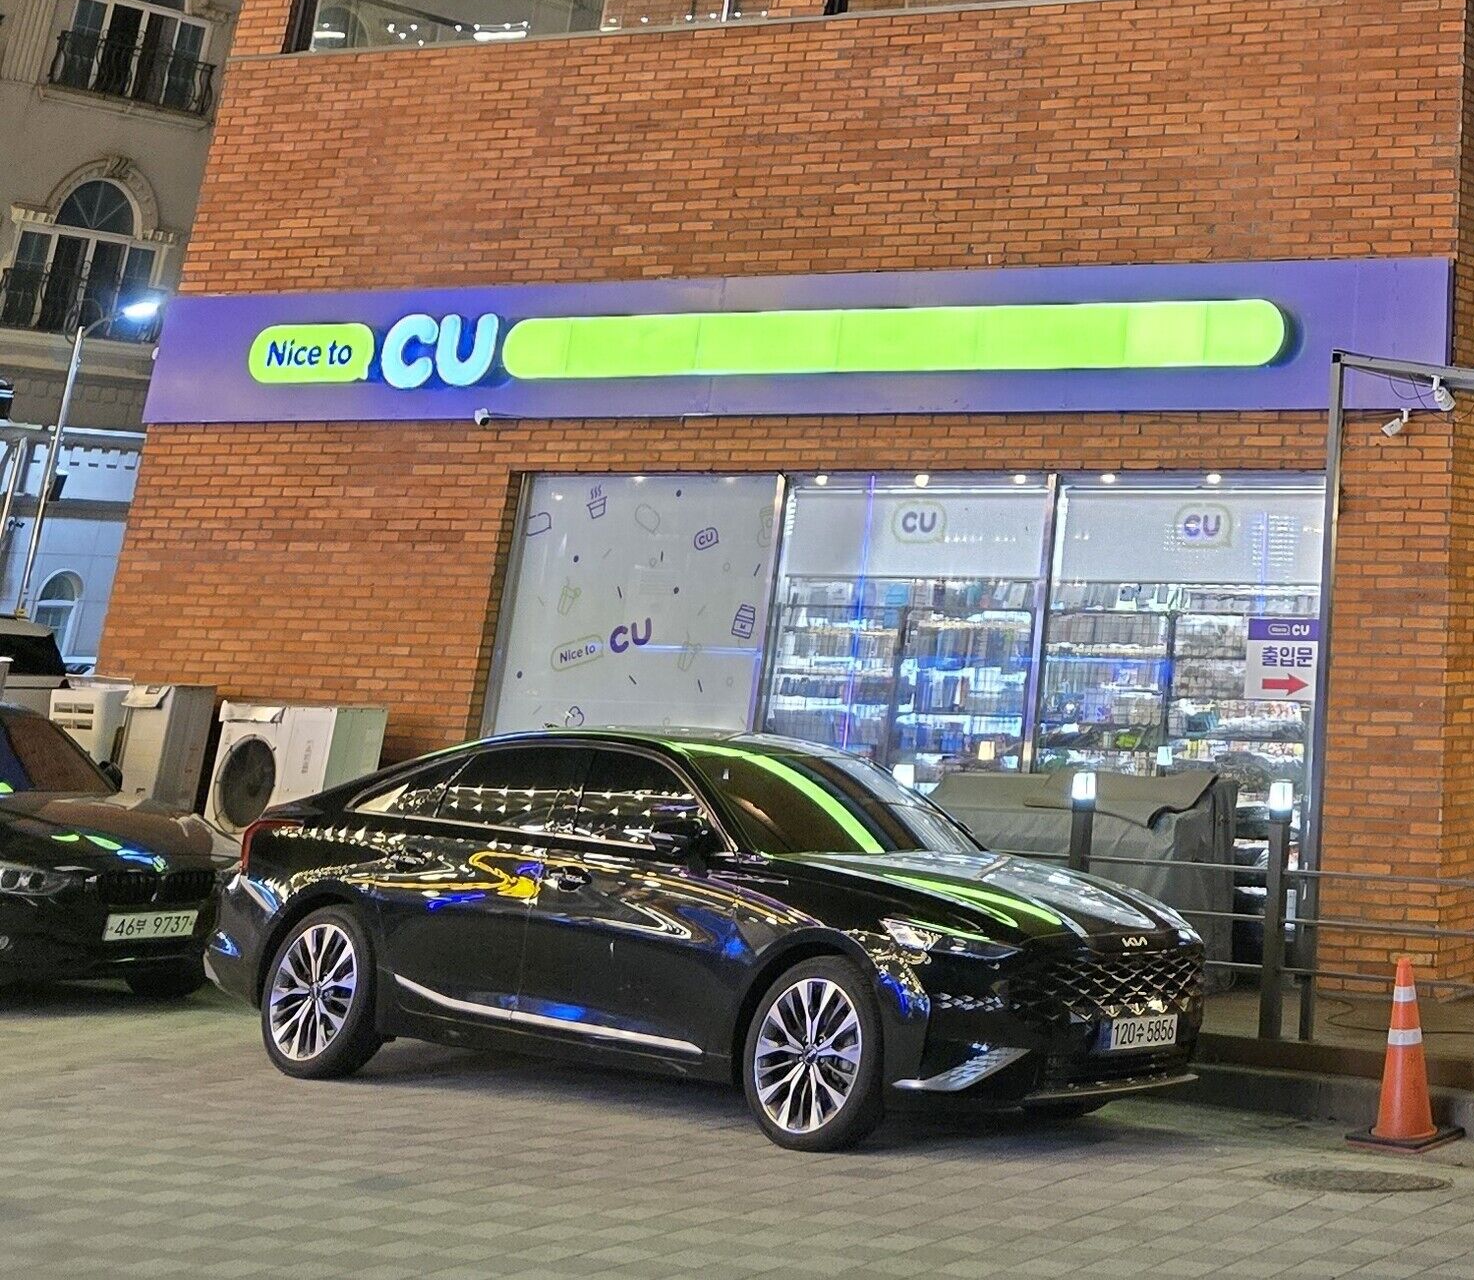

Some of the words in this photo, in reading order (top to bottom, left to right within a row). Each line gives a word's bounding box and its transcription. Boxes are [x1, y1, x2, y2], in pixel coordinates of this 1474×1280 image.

[265, 339, 322, 367] Nice
[327, 341, 353, 365] to
[381, 312, 498, 390] CU
[902, 511, 937, 534] CU
[1184, 514, 1221, 537] CU
[699, 532, 714, 545] CU
[560, 648, 583, 664] Nice
[610, 617, 652, 653] CU
[1291, 623, 1310, 636] CU
[1262, 646, 1313, 667] 출입문
[115, 919, 147, 936] 46부
[153, 916, 191, 934] 9737
[1114, 1022, 1145, 1046] 120수
[1146, 1019, 1175, 1041] 5856
